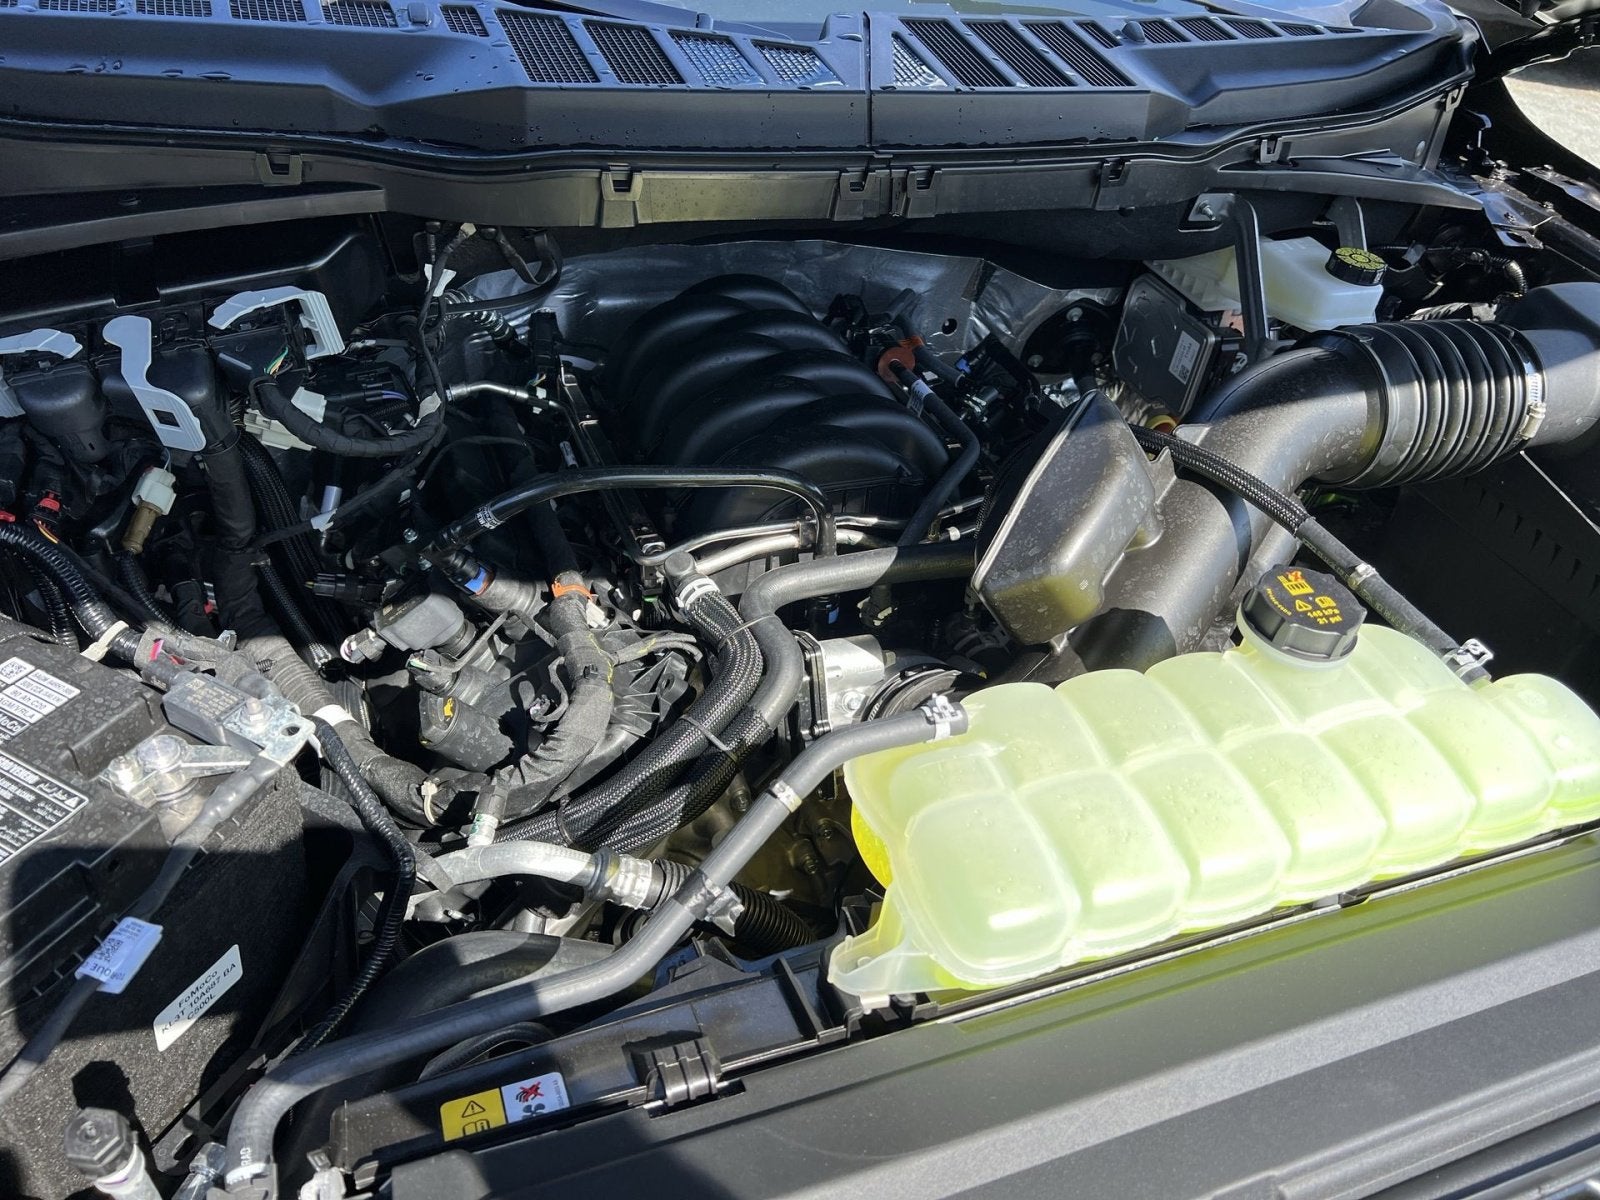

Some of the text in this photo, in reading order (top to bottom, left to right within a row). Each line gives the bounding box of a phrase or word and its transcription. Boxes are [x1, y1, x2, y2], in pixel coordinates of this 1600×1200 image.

[161, 962, 236, 1034] KL3T 10A687 BA
[178, 970, 218, 1008] FoMoCo
[187, 993, 215, 1020] C500L
[240, 1147, 251, 1166] RAD
